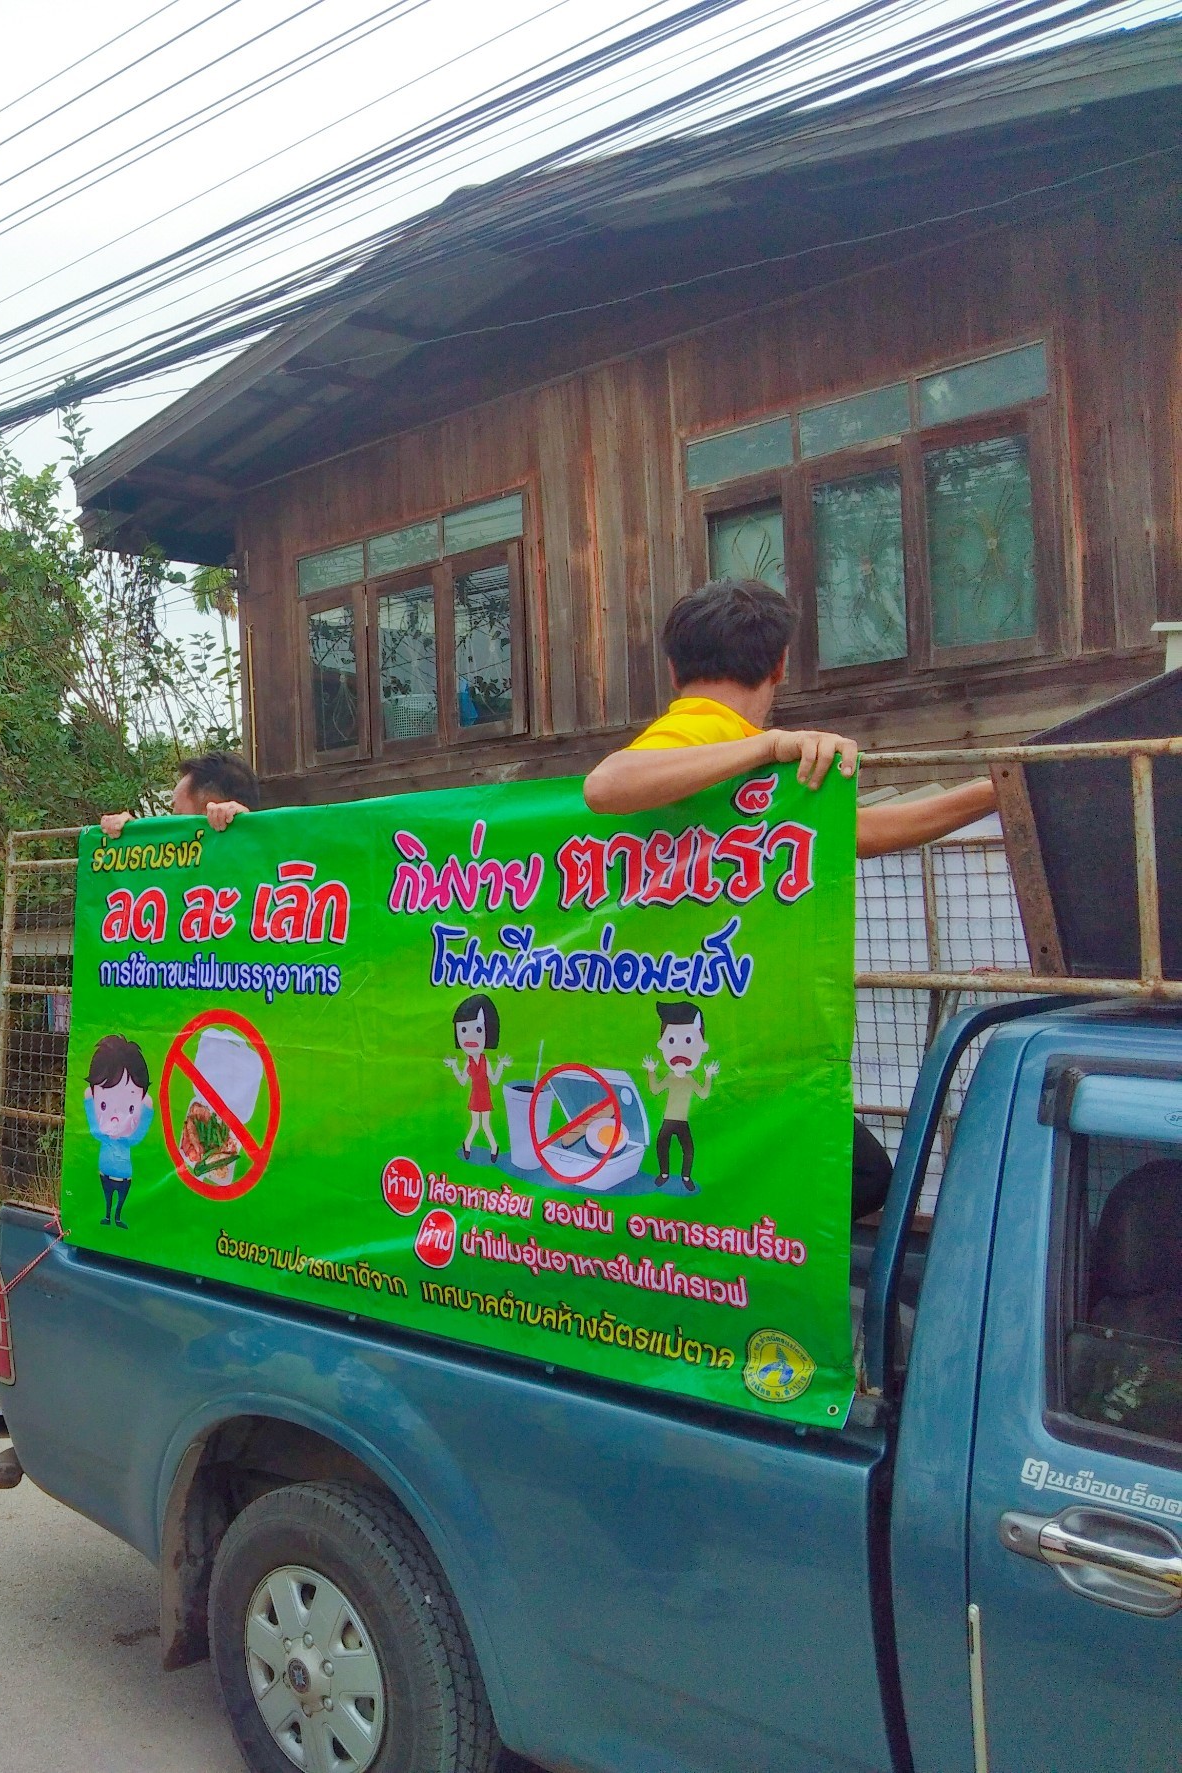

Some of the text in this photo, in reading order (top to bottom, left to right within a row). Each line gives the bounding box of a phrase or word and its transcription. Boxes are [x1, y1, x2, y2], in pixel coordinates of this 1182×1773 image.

[92, 830, 204, 872] ร่วมรณรงค์
[388, 773, 818, 913] กินง่าย ตายเร็ว
[101, 861, 351, 944] ลด ละ เลิก
[99, 952, 341, 1003] การใช้ภาชนะโฟมบรรจุอาหาร
[429, 917, 754, 997] โฟมมีสารก่อมะเร็ง
[387, 1166, 808, 1267] ห้าม ใส่อาหารร้อน ของมัน อาหารรสเปรี้ยว
[216, 1229, 736, 1370] ด้วยความปรารถนาดีจาก เทศบาลตำบลห้างฉัตรแม่ตาล
[418, 1218, 749, 1309] ห้าม นำโฟมอุ่นอาหารในไมโครเวฟ
